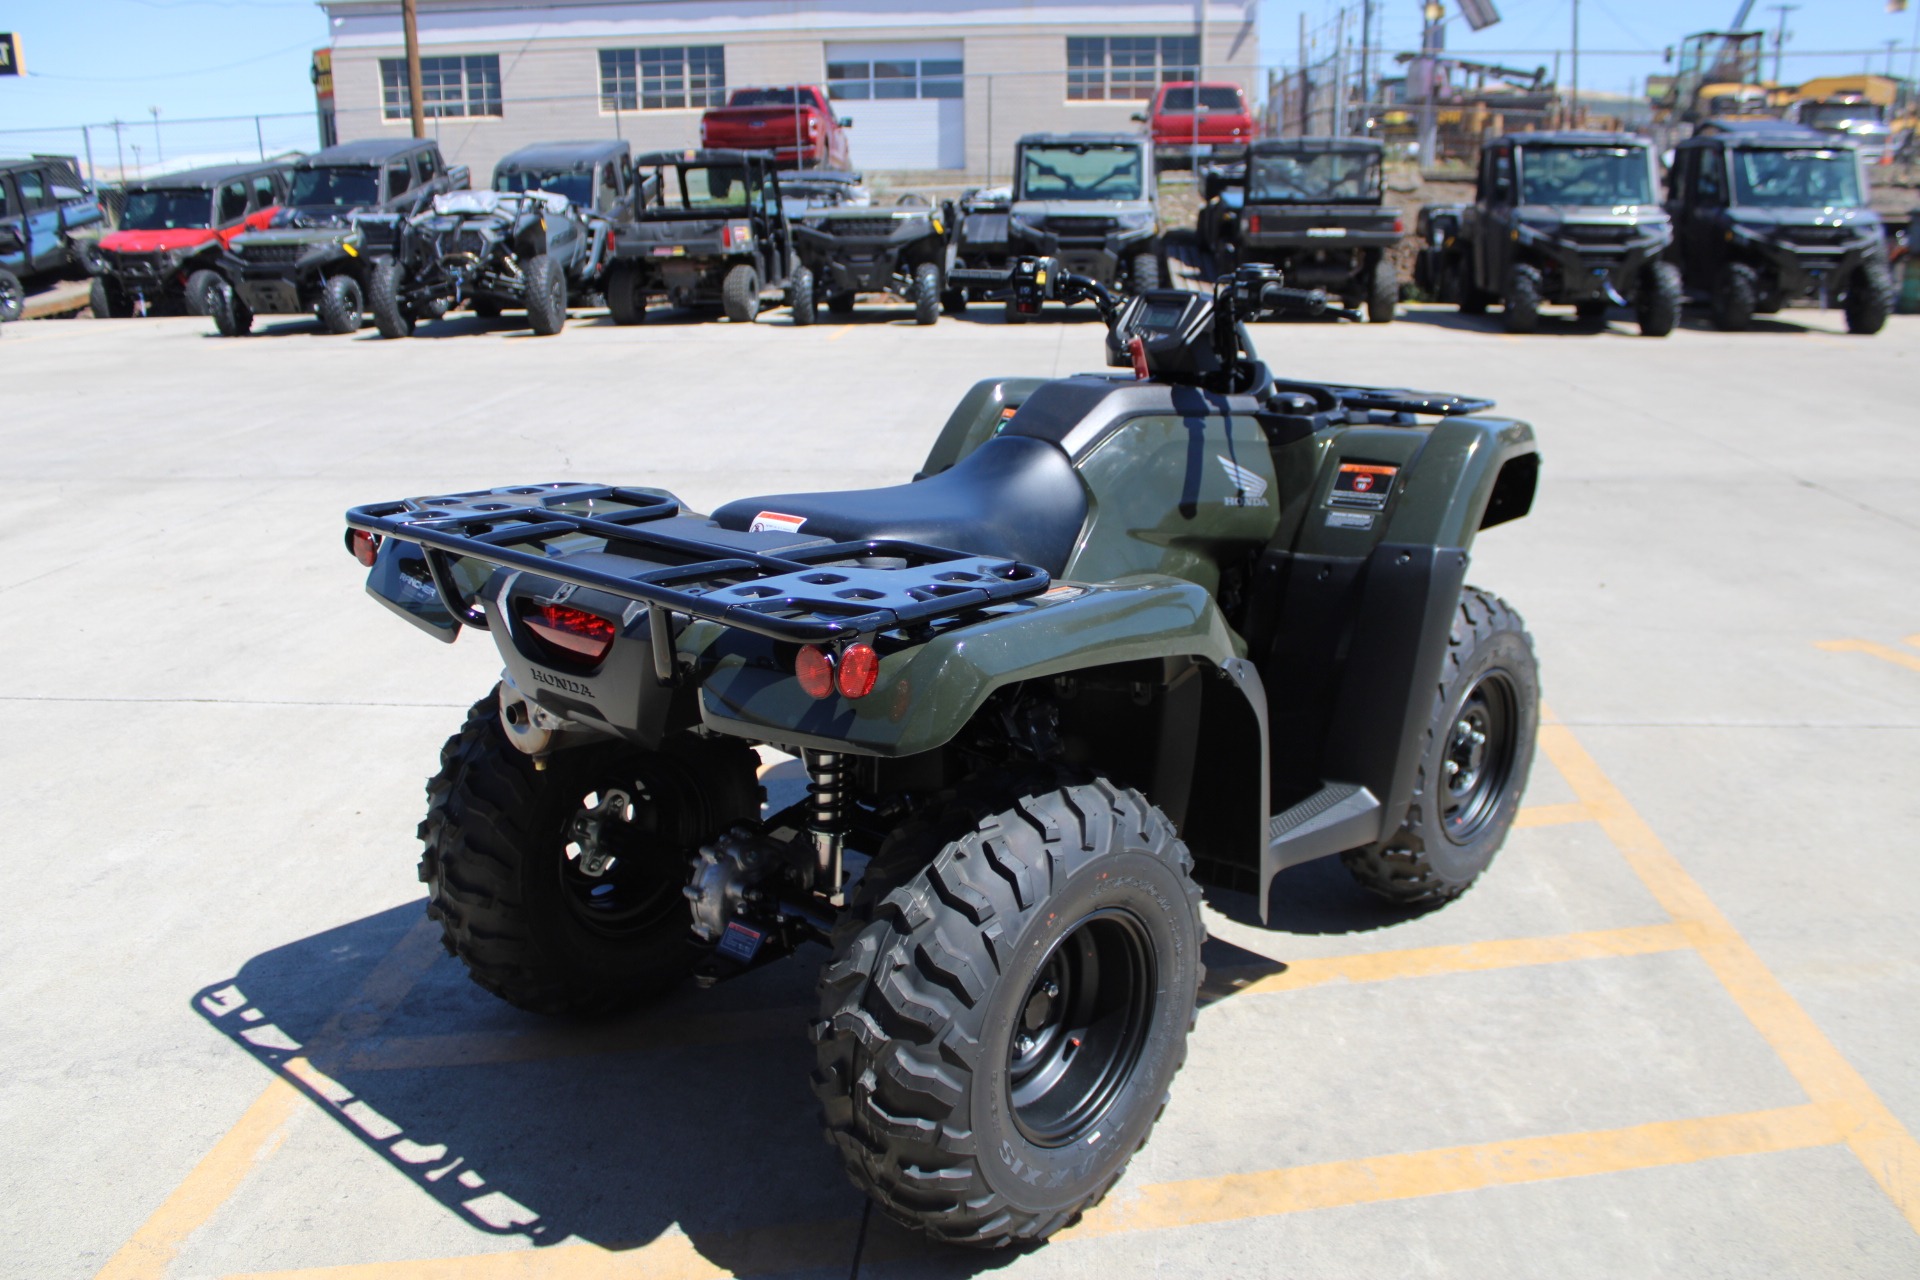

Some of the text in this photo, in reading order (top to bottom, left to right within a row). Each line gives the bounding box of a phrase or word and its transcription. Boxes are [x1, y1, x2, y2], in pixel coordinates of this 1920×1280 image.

[1223, 496, 1270, 507] HONDA
[399, 572, 436, 598] RANCHER
[530, 667, 596, 699] HONDA
